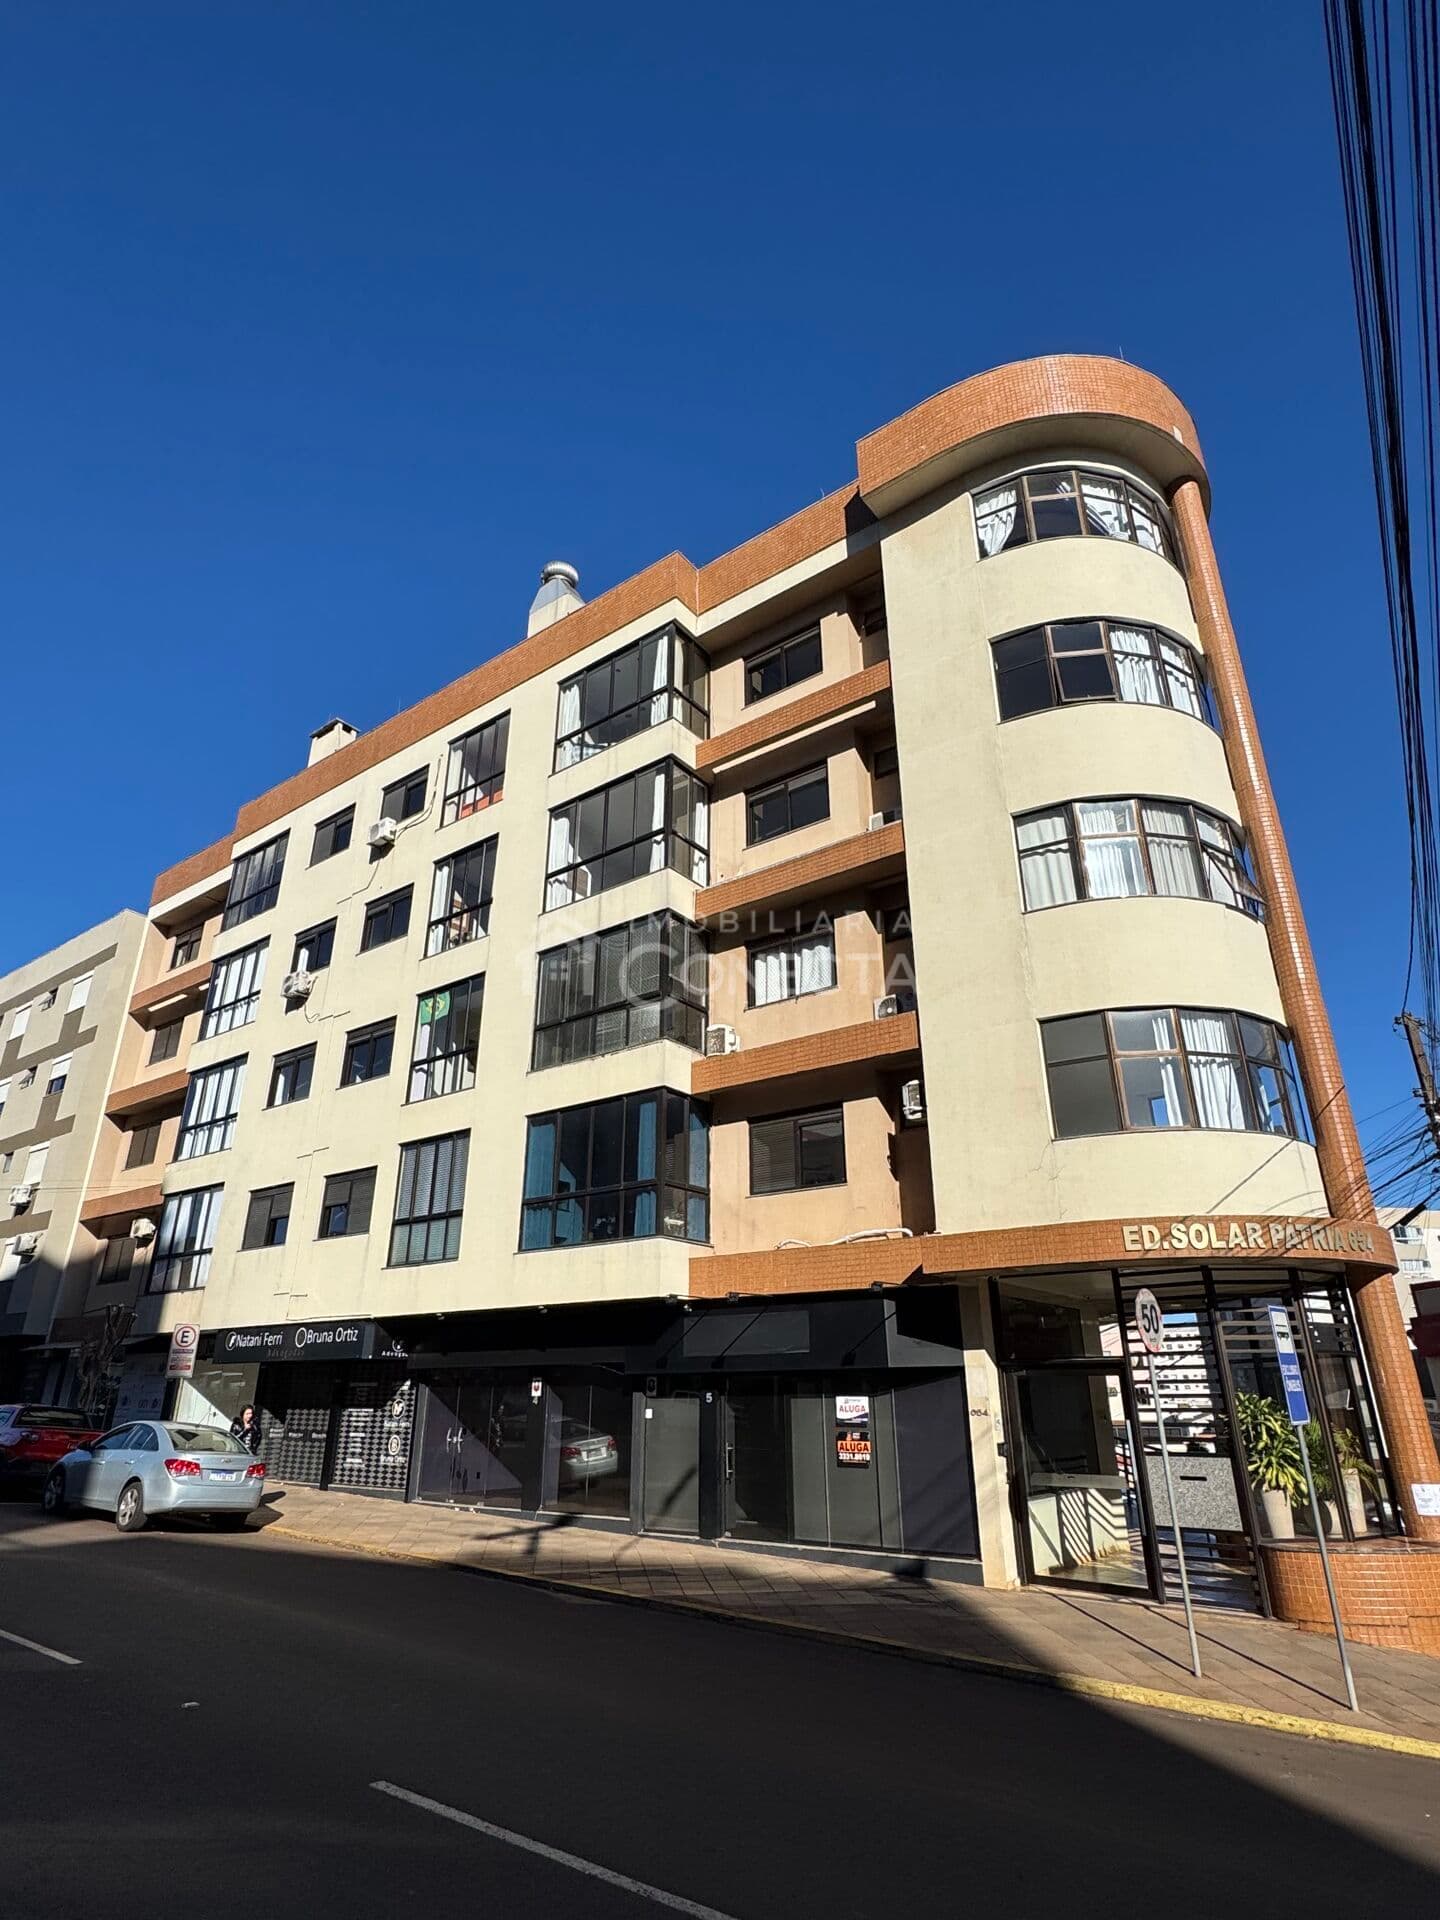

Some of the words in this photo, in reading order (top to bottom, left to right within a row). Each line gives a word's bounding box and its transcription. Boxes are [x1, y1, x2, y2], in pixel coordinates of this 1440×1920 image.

[1141, 1303, 1159, 1334] 50
[181, 1331, 190, 1343] E
[235, 1333, 262, 1347] Natani
[263, 1331, 283, 1346] Ferri
[307, 1328, 334, 1343] Bruna
[335, 1326, 359, 1342] Ortiz
[705, 1392, 713, 1403] 5
[839, 1405, 866, 1413] ALUGA
[839, 1442, 869, 1452] ALUGA
